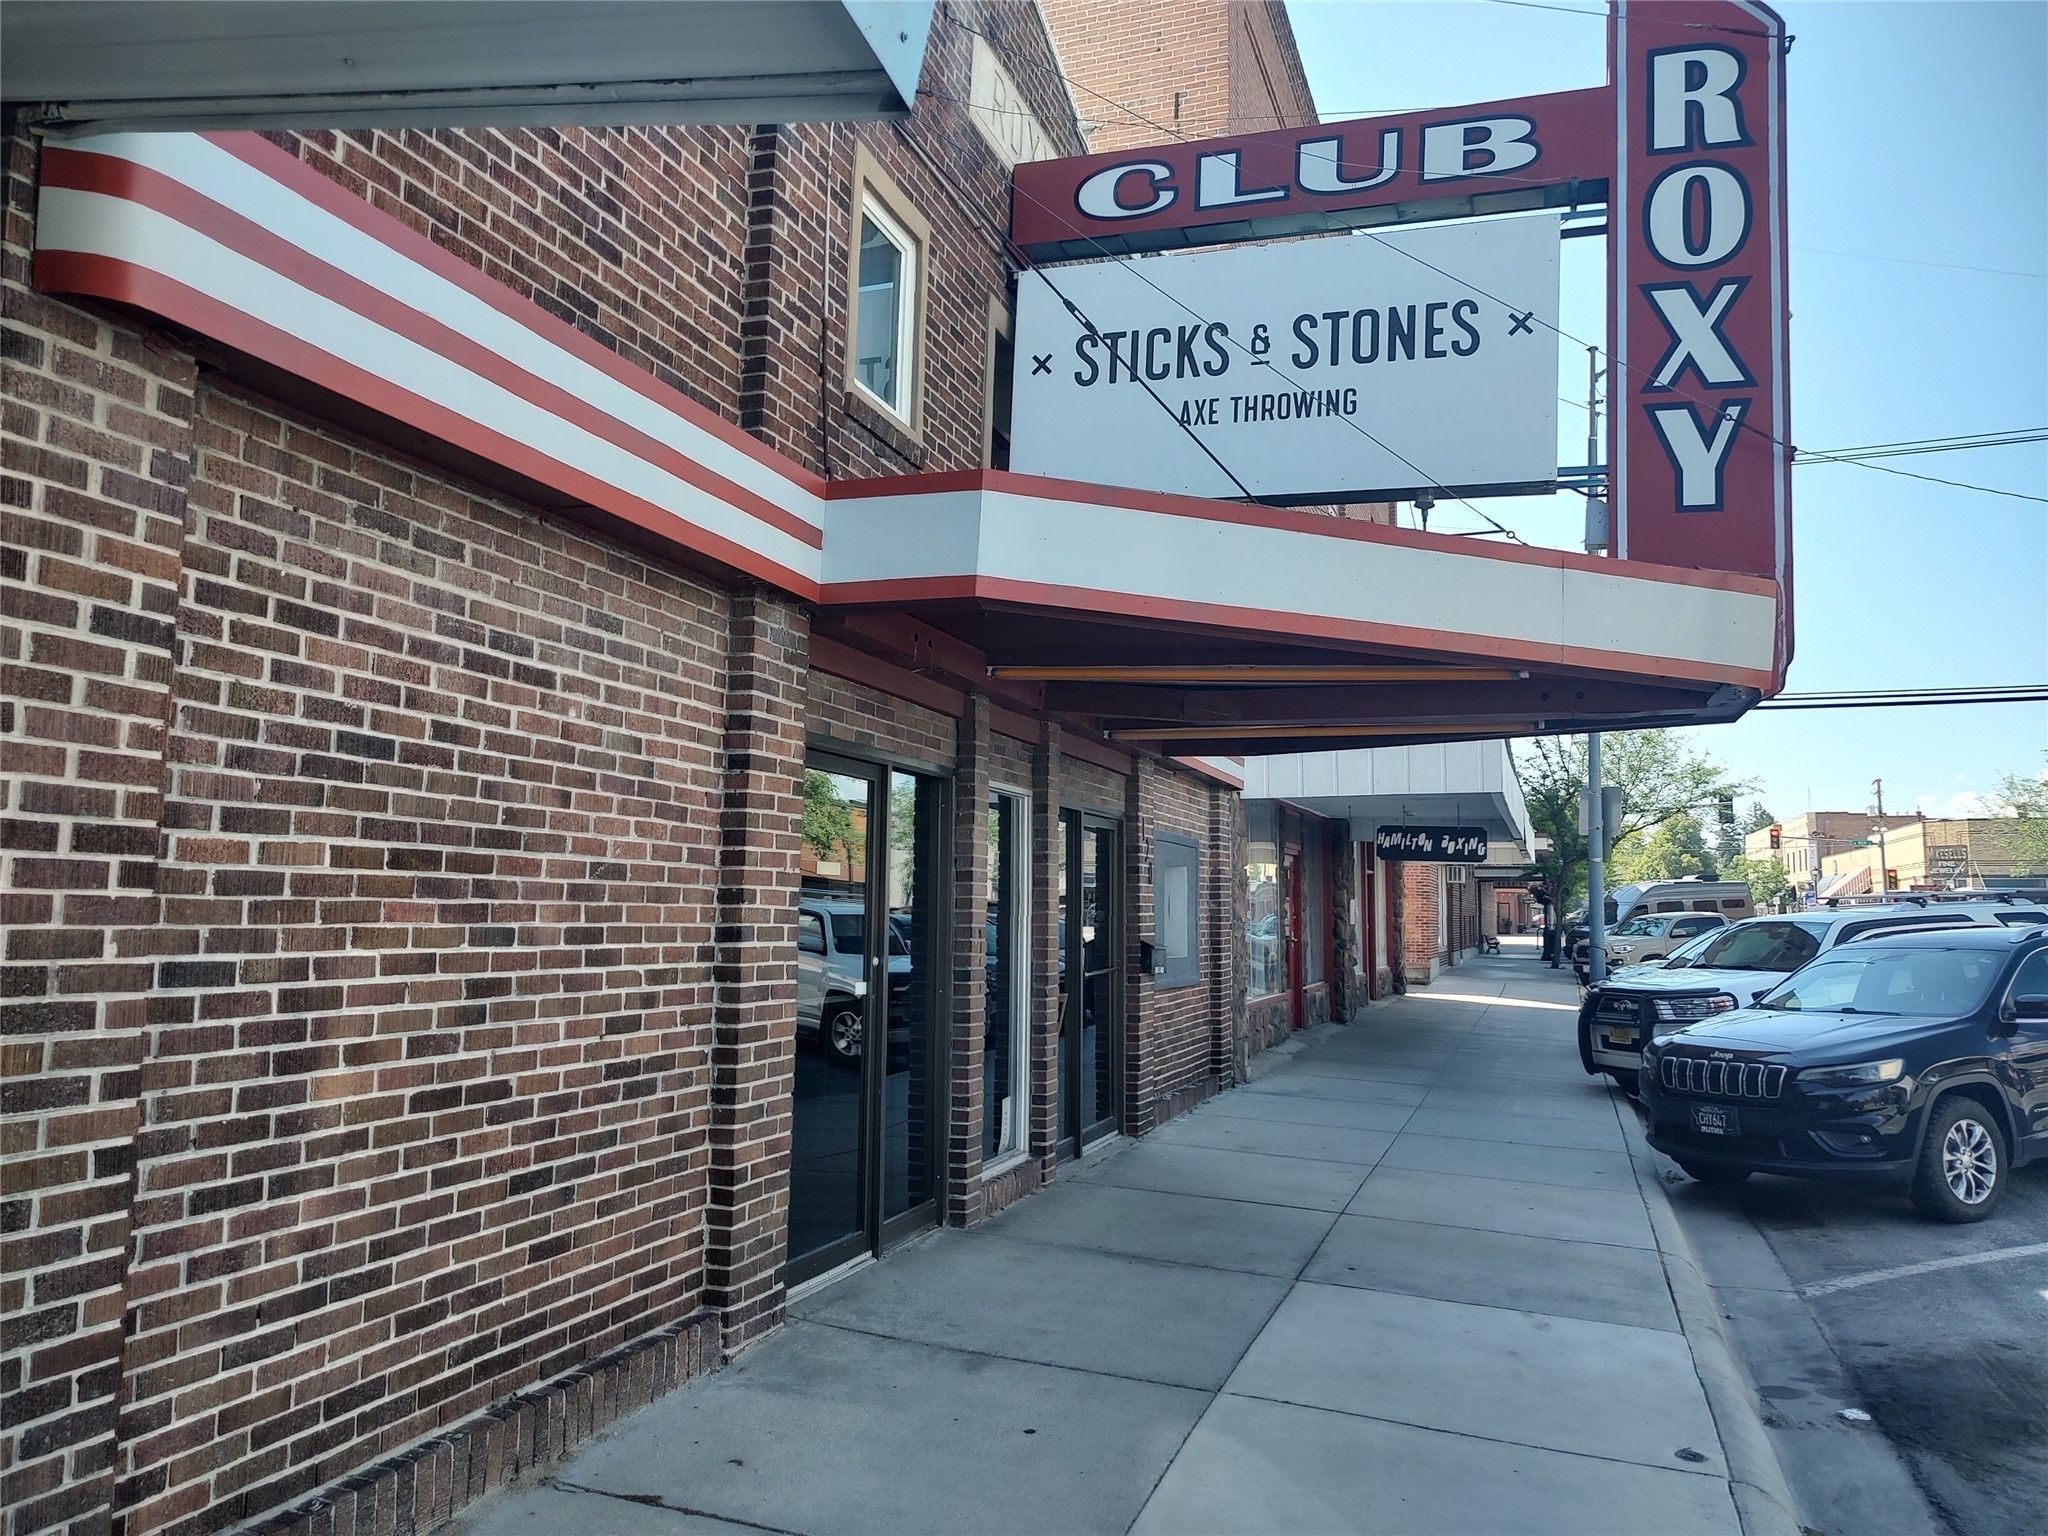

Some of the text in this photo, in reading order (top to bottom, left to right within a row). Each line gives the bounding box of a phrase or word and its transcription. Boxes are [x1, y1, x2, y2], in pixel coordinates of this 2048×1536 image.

[1076, 114, 1541, 220] CLUB
[1641, 43, 1757, 512] ROXY
[1074, 299, 1480, 387] STICKS & STONES
[1178, 387, 1357, 427] AXE THROWING
[1377, 832, 1486, 856] HAMILTON BOXING
[1710, 1050, 1733, 1060] Jeep
